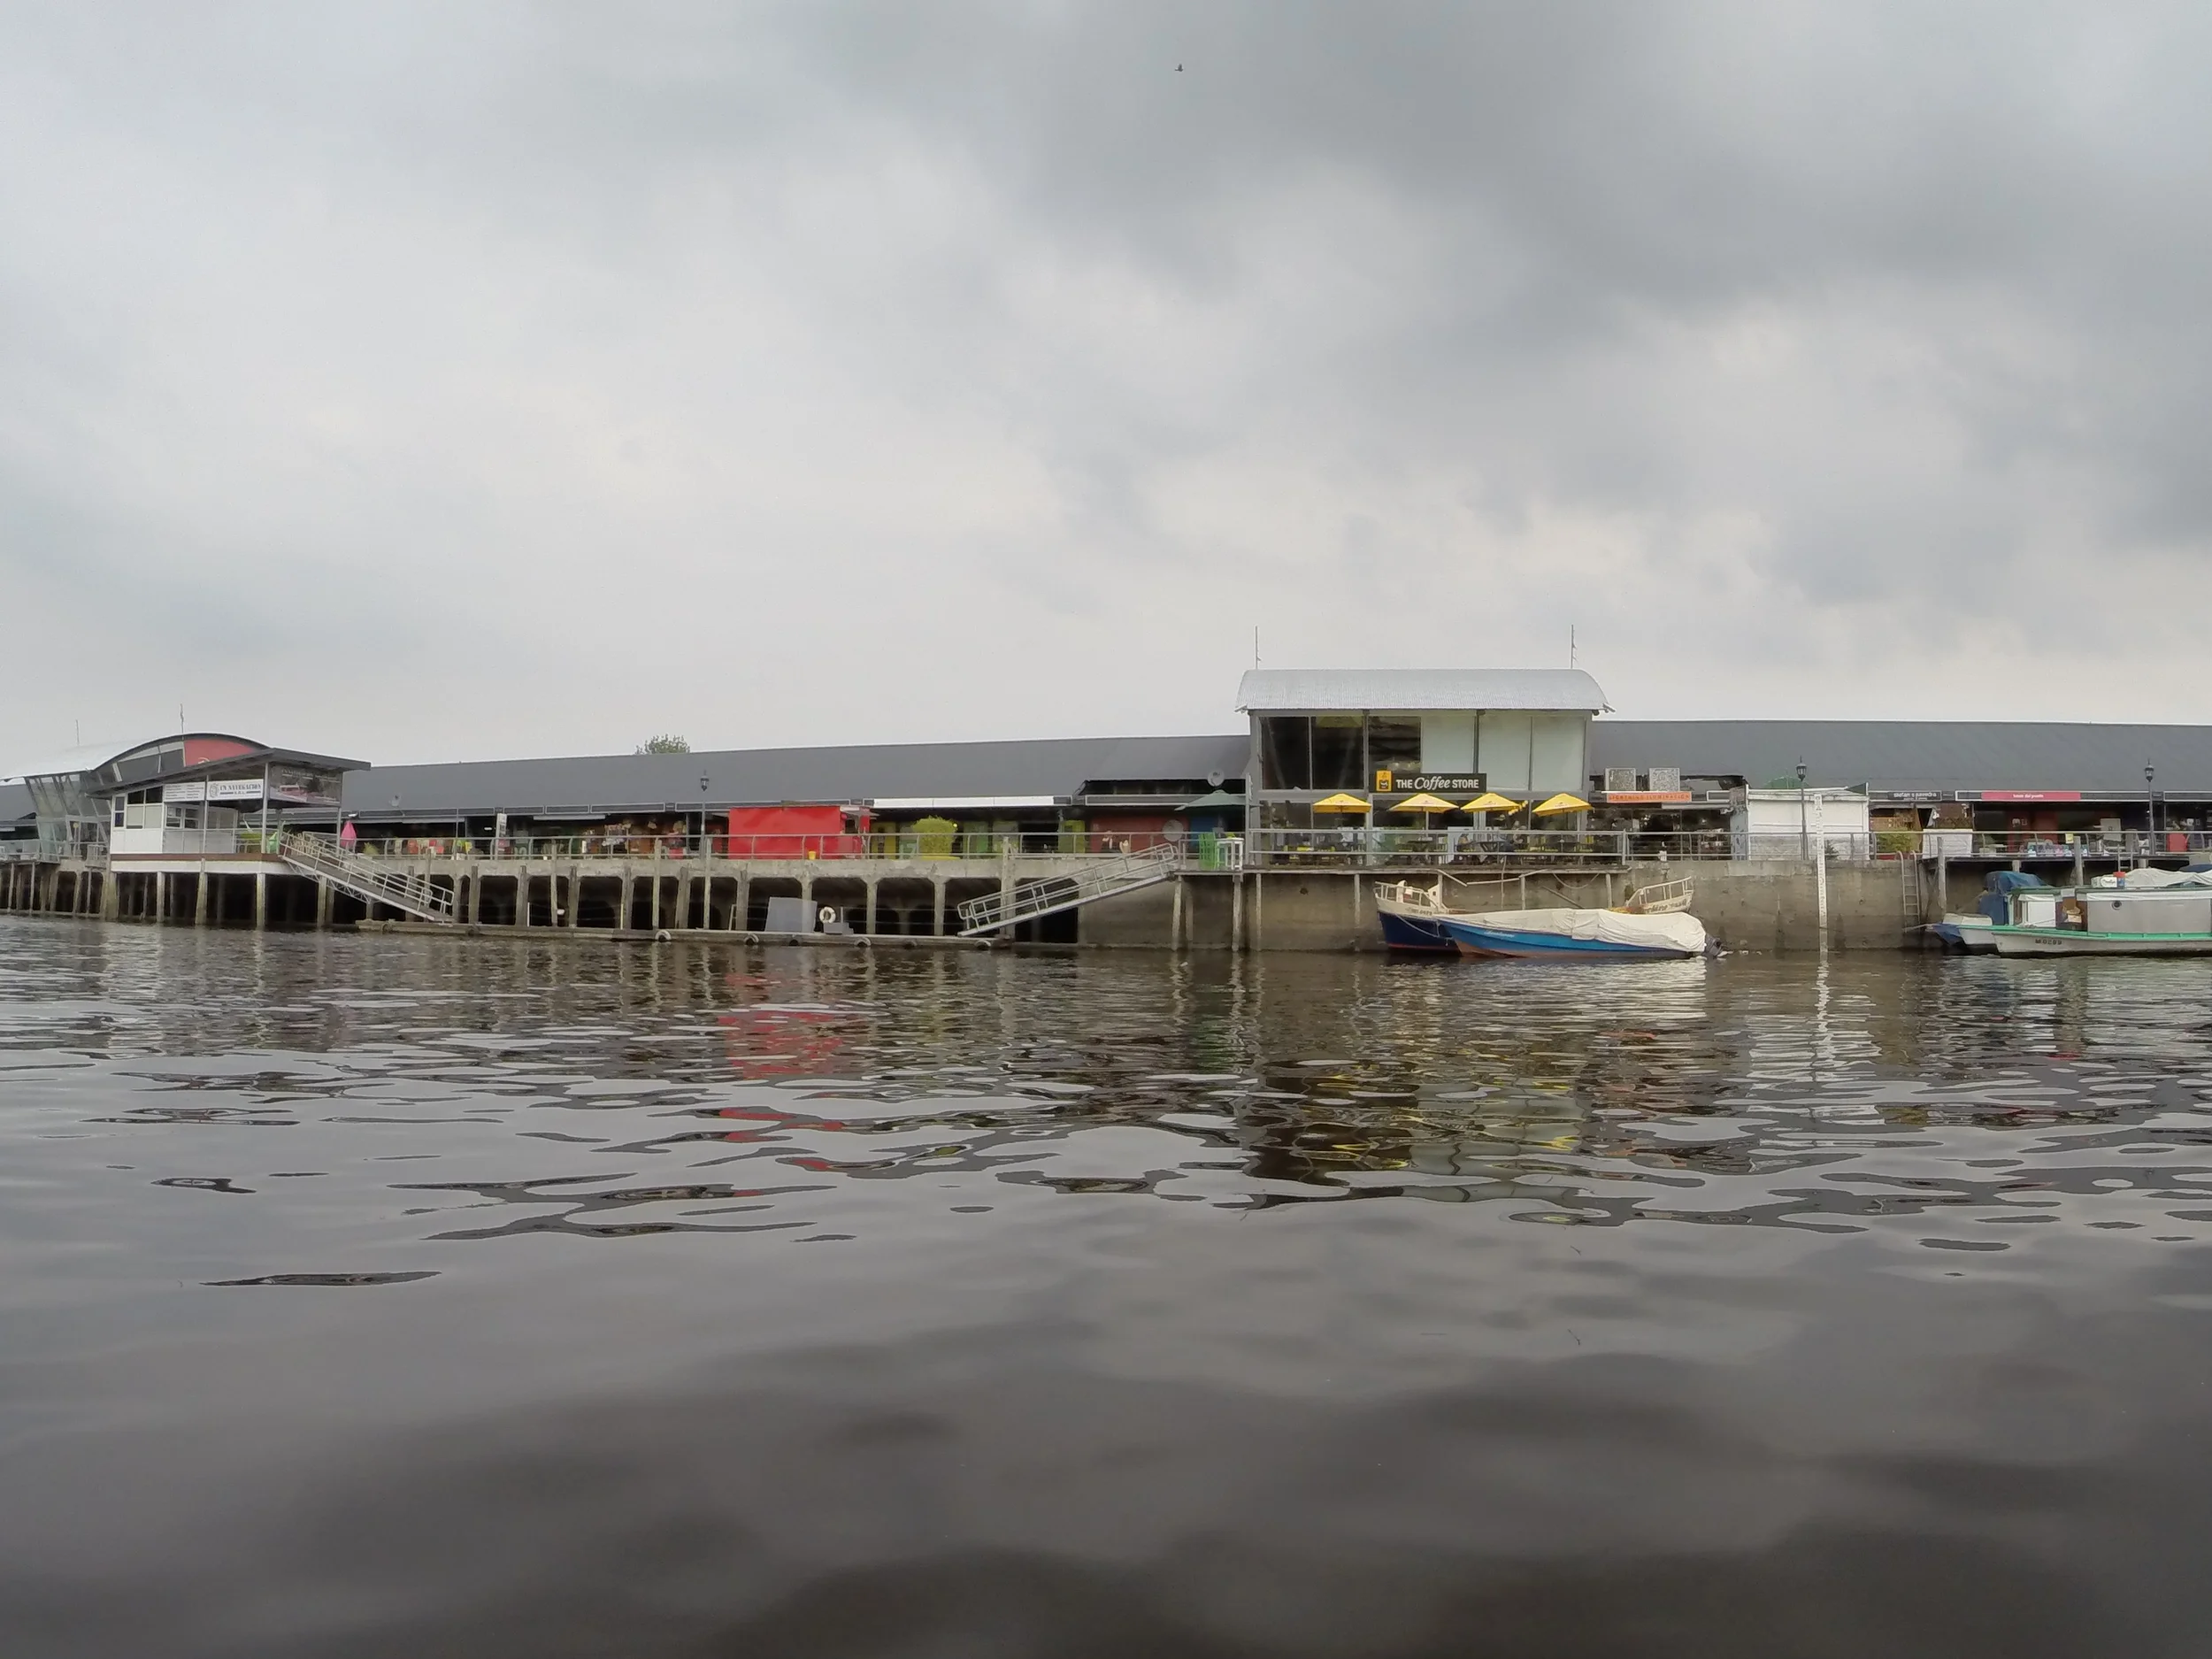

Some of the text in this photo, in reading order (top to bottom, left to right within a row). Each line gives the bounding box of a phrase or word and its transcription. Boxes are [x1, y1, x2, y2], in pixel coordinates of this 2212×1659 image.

[1395, 776, 1479, 790] THE Coffee STORE
